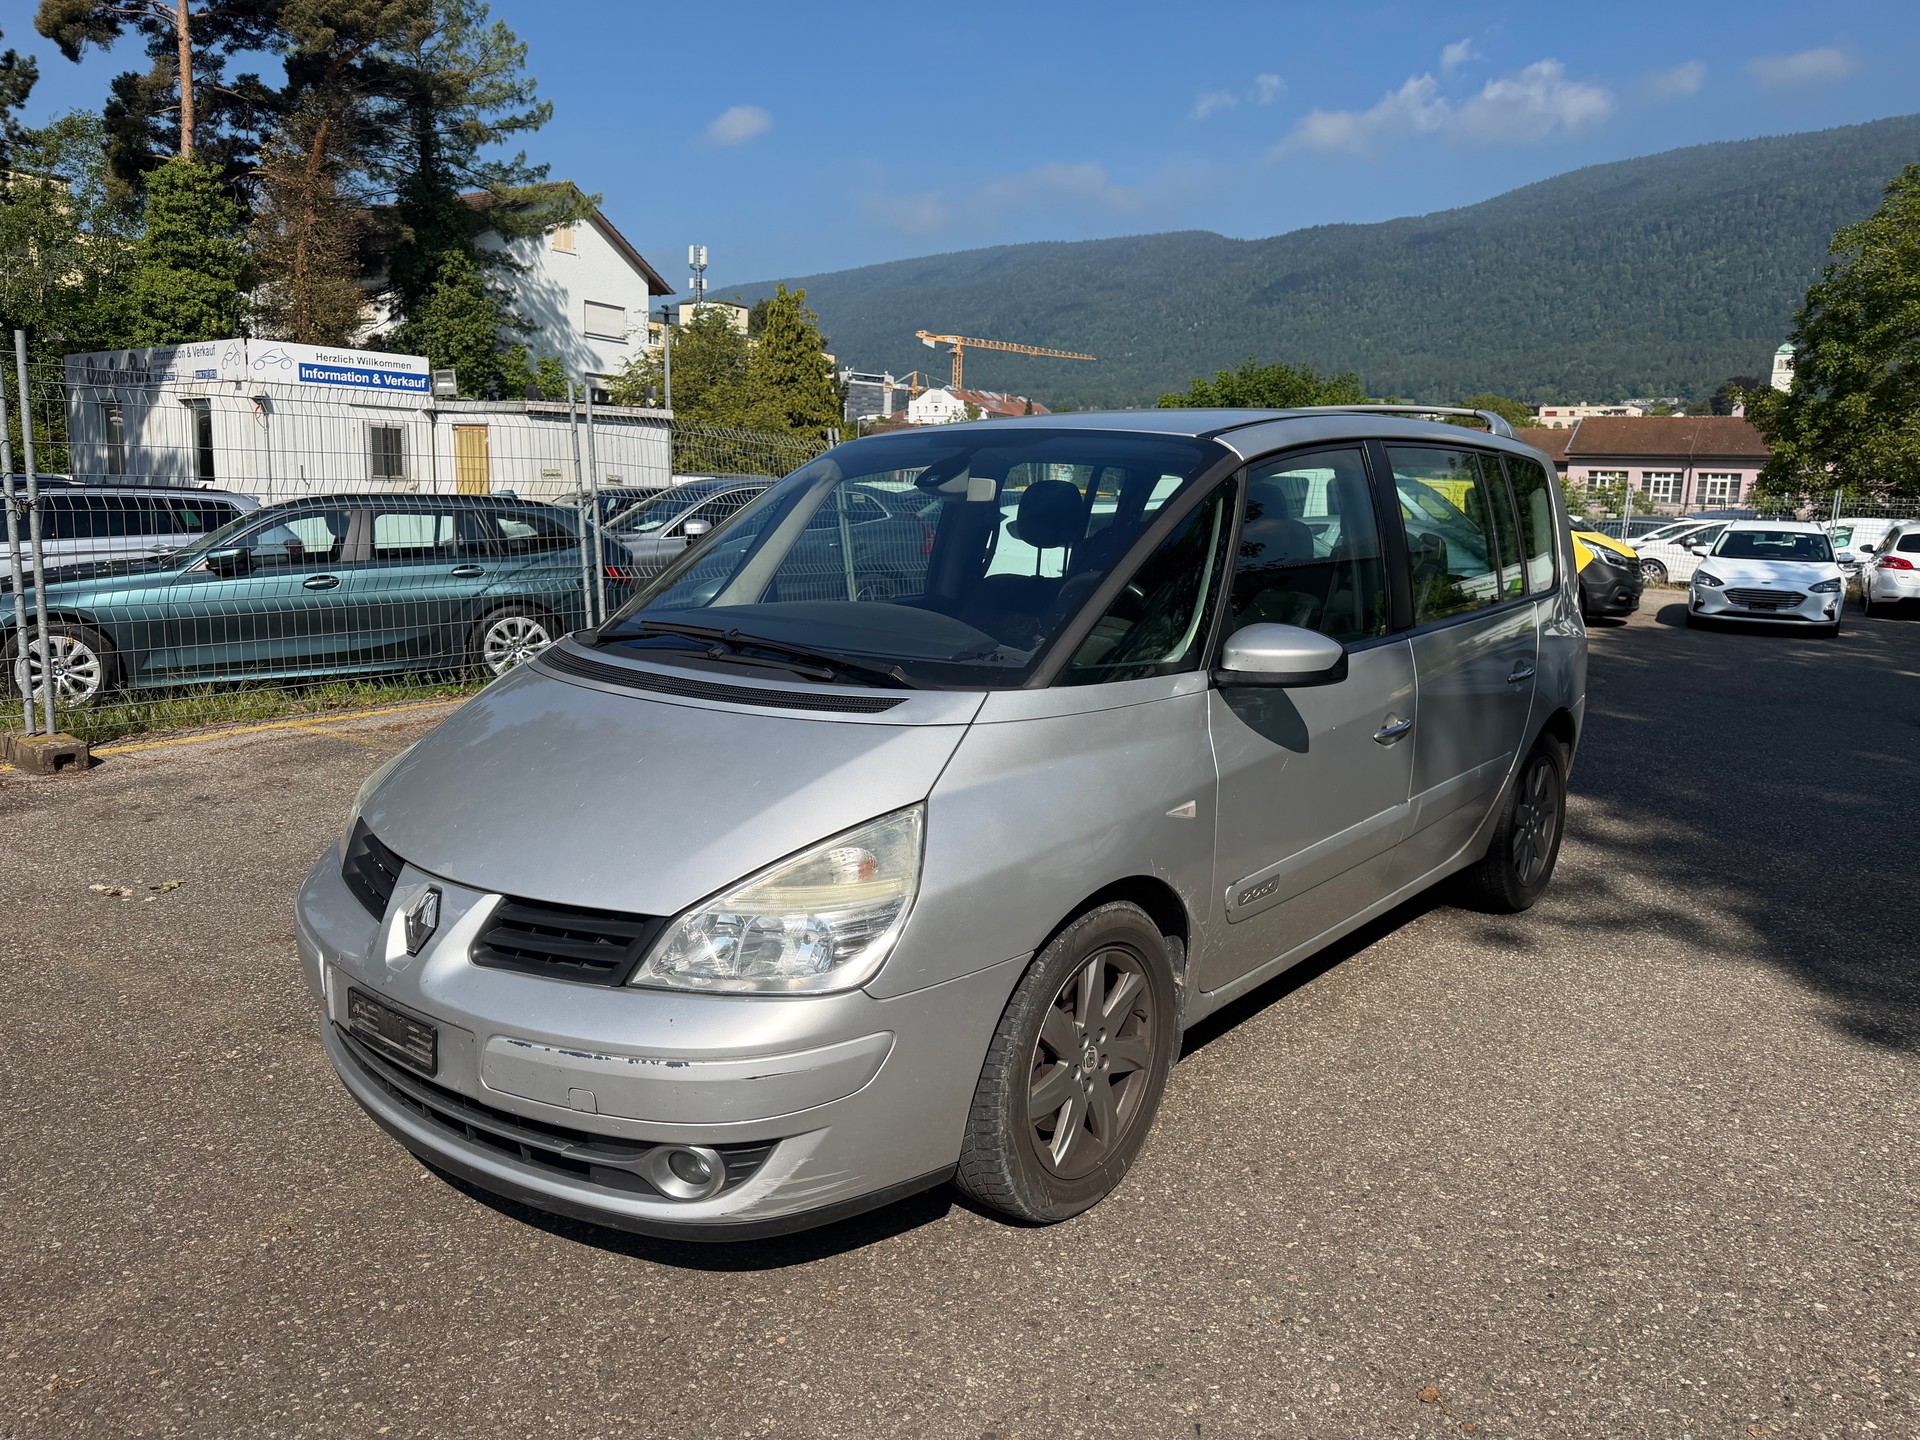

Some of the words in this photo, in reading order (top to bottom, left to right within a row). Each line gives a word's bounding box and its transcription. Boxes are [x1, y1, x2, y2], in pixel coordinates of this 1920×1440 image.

[187, 346, 192, 358] &
[192, 344, 216, 358] Verkauf
[315, 352, 355, 365] Herzlich
[356, 356, 412, 370] Willkommen
[301, 367, 370, 384] Information
[372, 373, 382, 385] &
[383, 374, 427, 388] Verkauf
